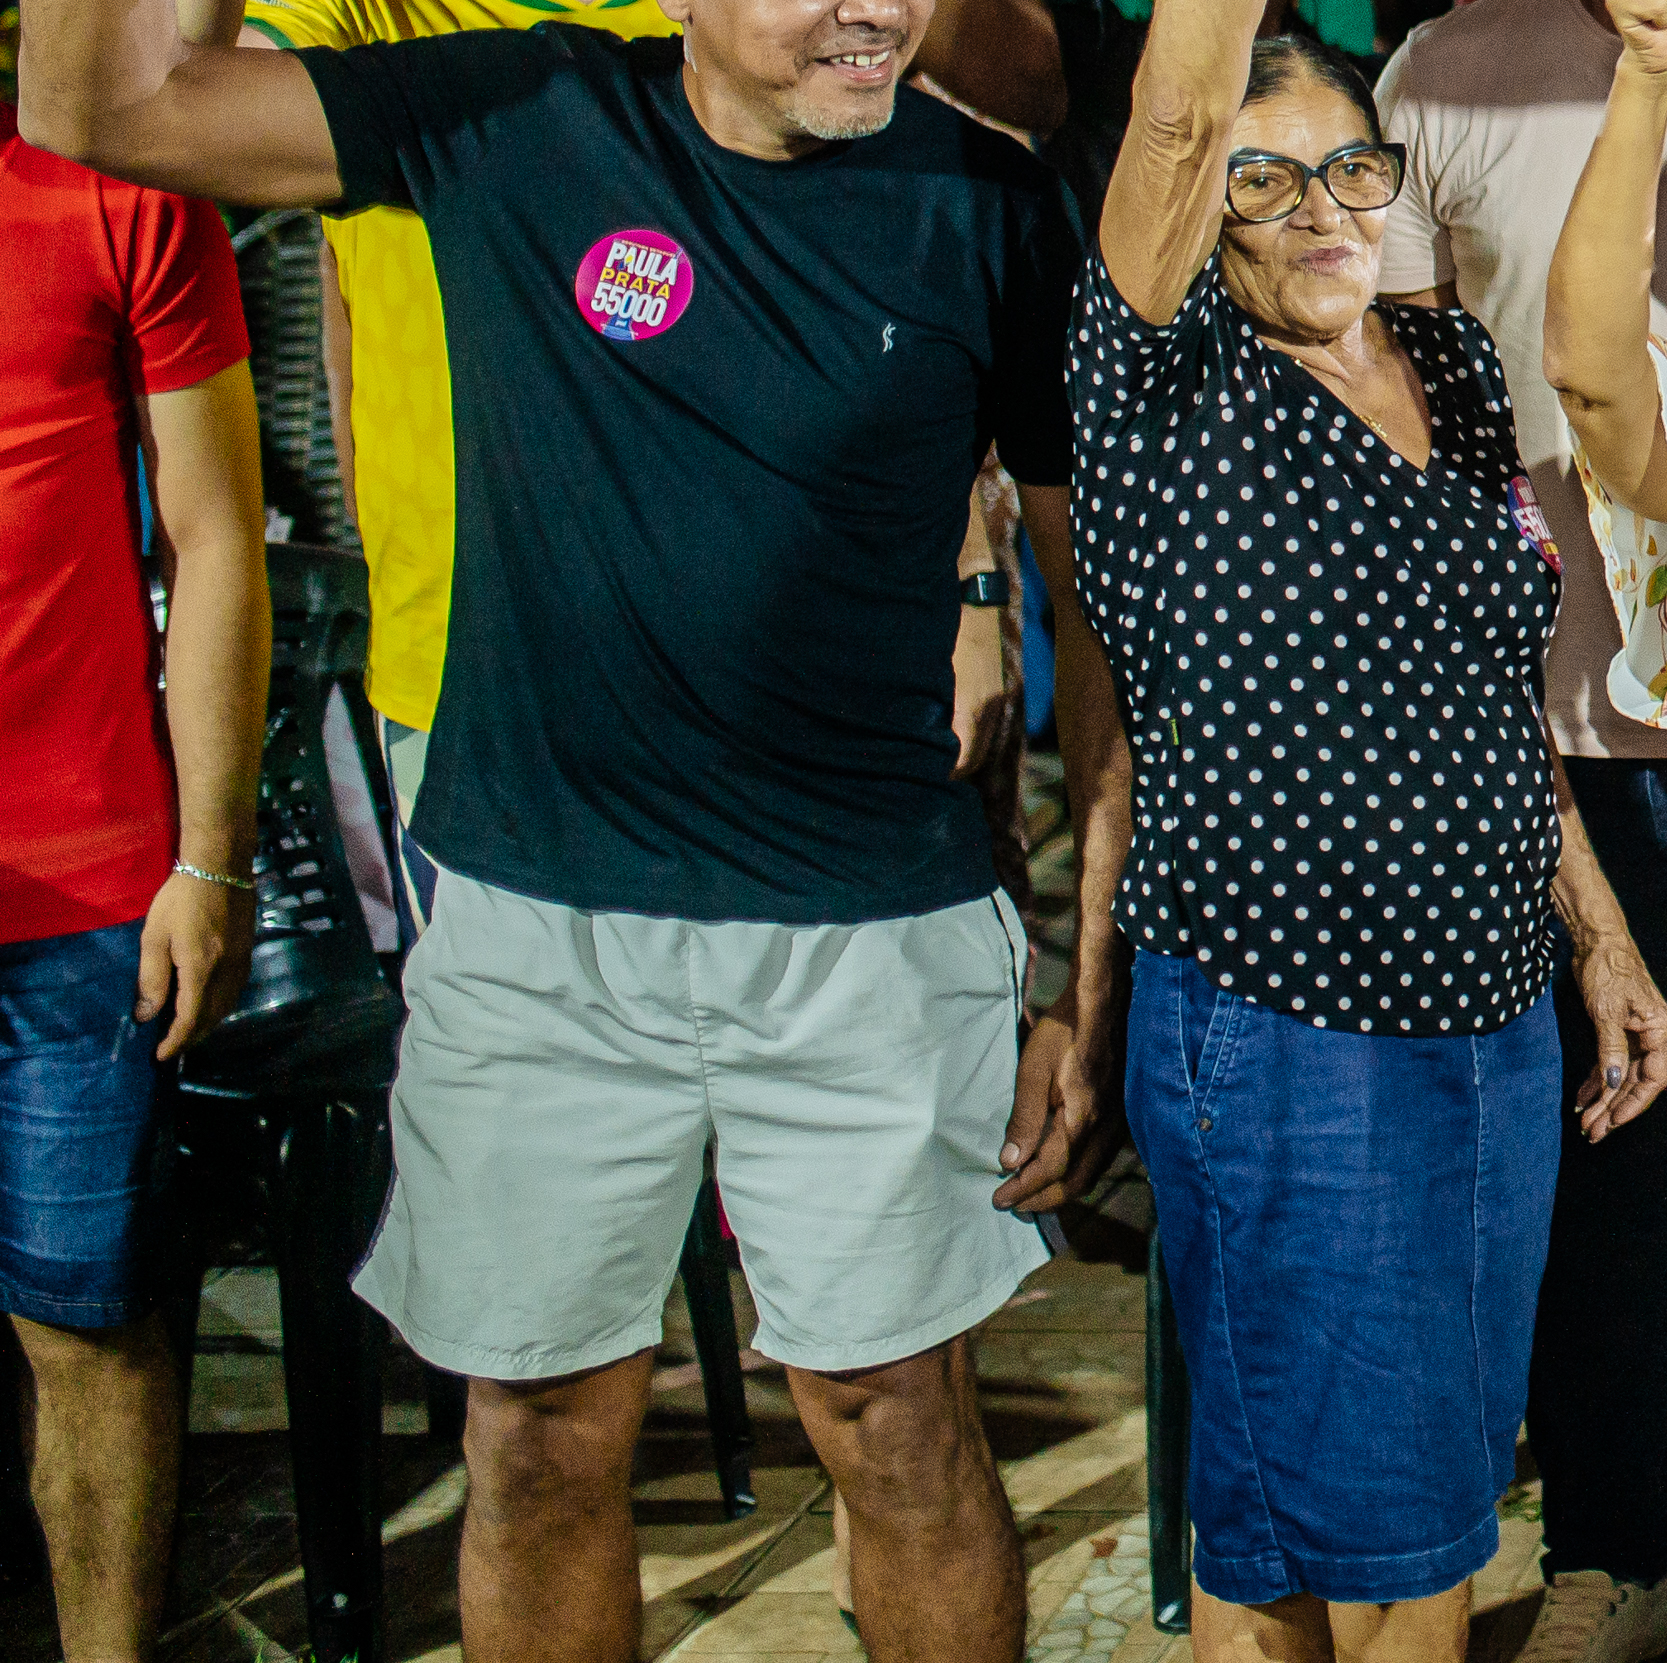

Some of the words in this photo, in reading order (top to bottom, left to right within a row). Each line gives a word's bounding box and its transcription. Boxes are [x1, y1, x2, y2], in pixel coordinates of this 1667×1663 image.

[600, 267, 671, 300] PRATA
[604, 239, 679, 286] PAULA
[590, 281, 668, 327] 55000
